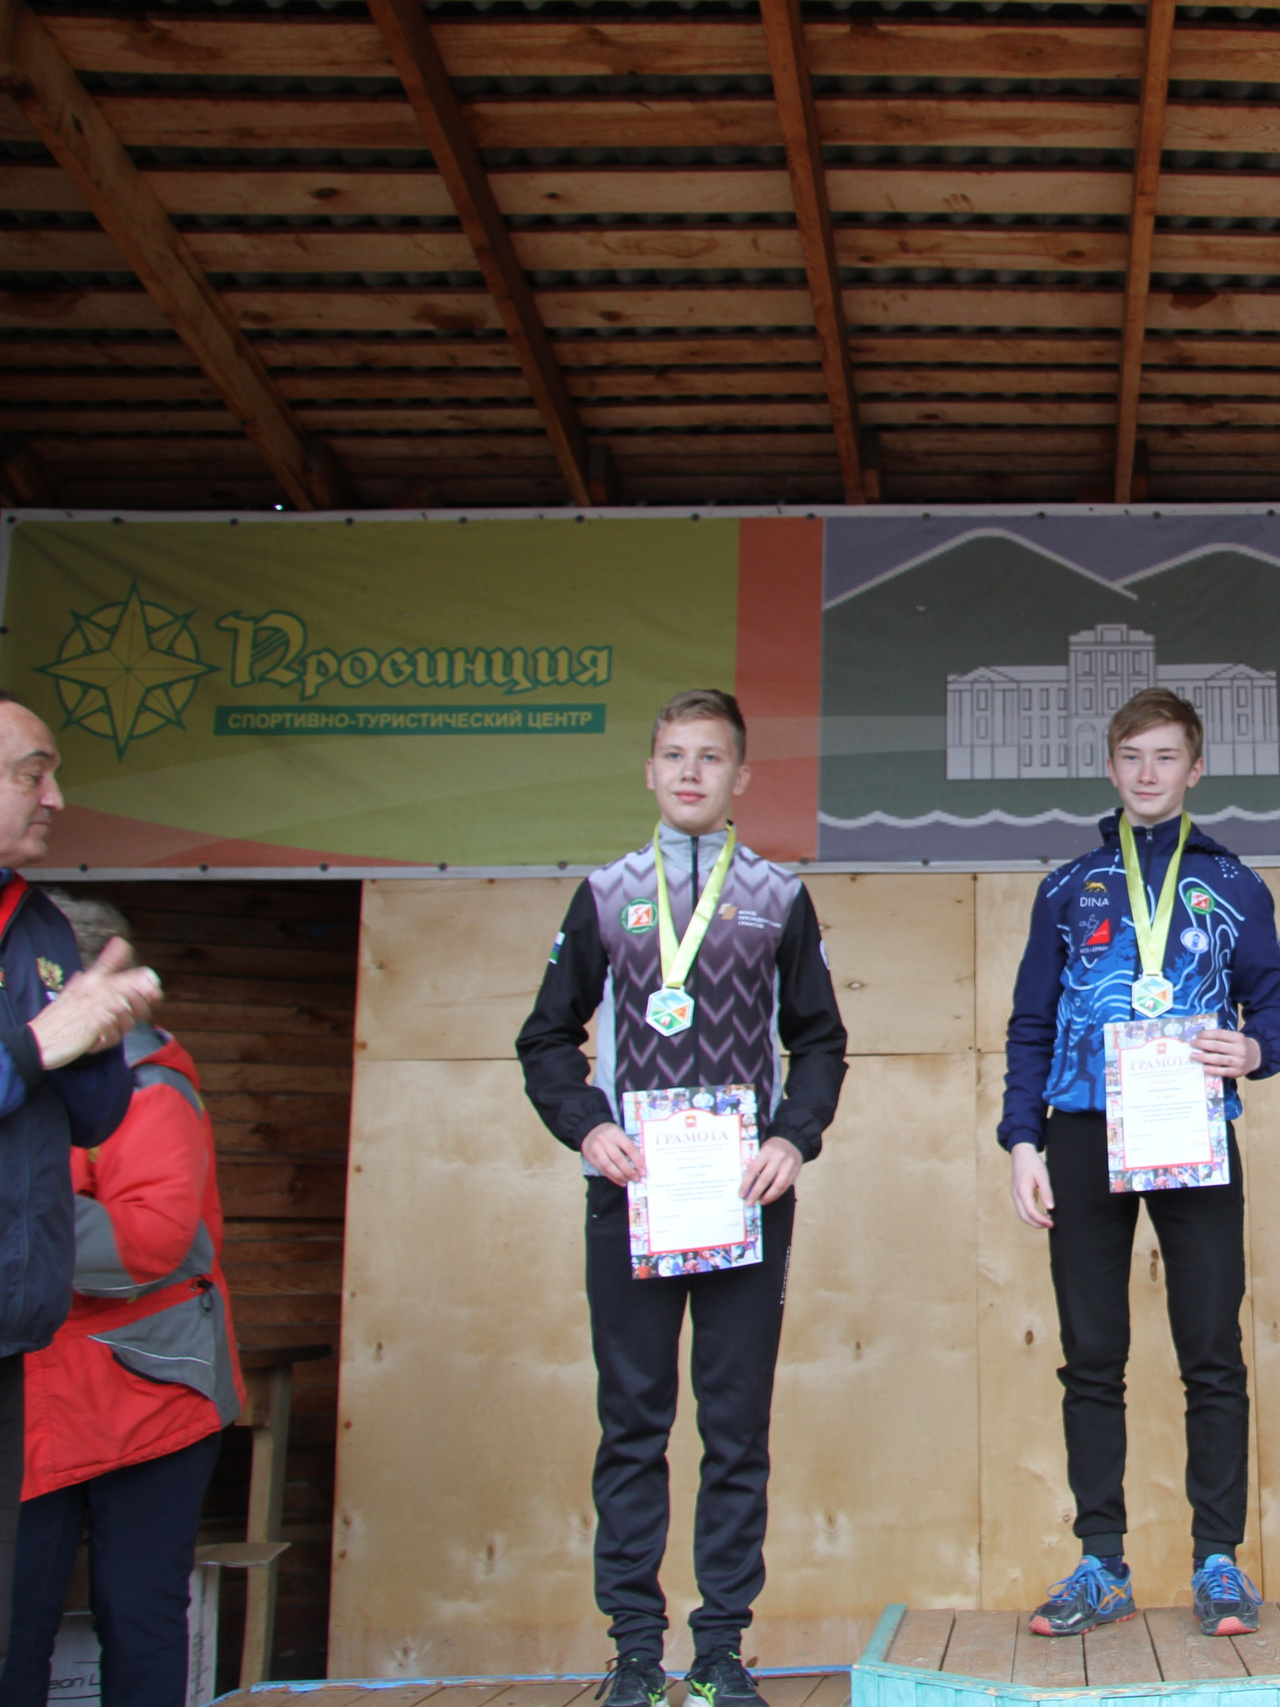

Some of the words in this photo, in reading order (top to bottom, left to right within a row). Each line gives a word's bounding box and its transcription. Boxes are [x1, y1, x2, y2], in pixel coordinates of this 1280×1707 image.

[215, 610, 613, 702] Провинция
[227, 709, 523, 730] СПОРТИВНО-ТУРИСТИЧЕСКИЙ
[527, 711, 593, 730] ЦЕНТР
[1080, 897, 1109, 907] DINA
[654, 1130, 729, 1145] ГРАМОТА
